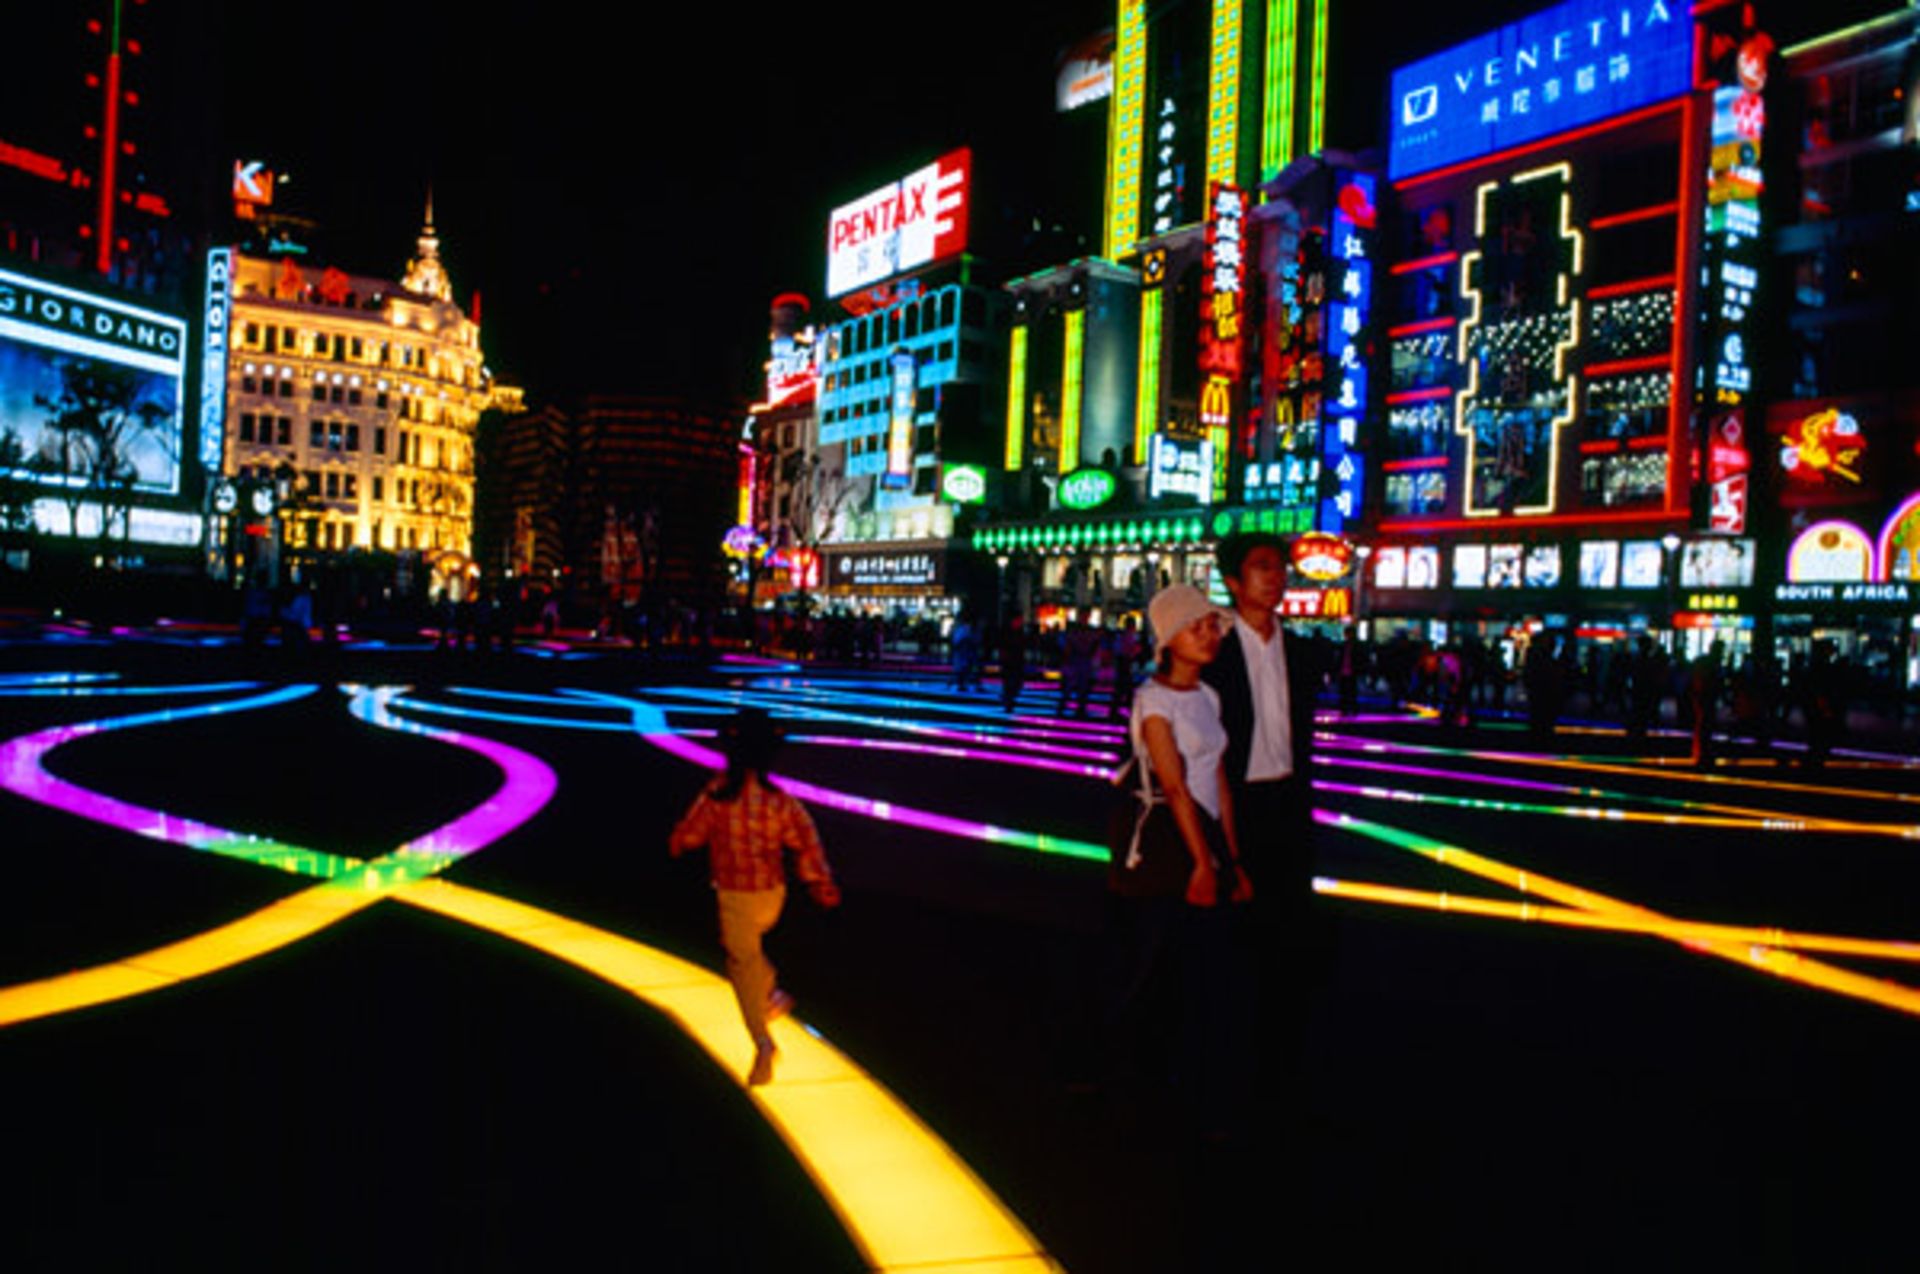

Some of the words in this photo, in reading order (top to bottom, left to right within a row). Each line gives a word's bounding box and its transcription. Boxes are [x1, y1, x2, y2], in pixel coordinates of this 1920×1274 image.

[1454, 0, 1671, 93] VENETIA
[235, 159, 264, 197] K
[833, 181, 927, 256] PENTAX
[0, 286, 177, 351] GIORDANO
[1775, 585, 1834, 600] SOUTH
[1843, 584, 1909, 600] AFRICA
